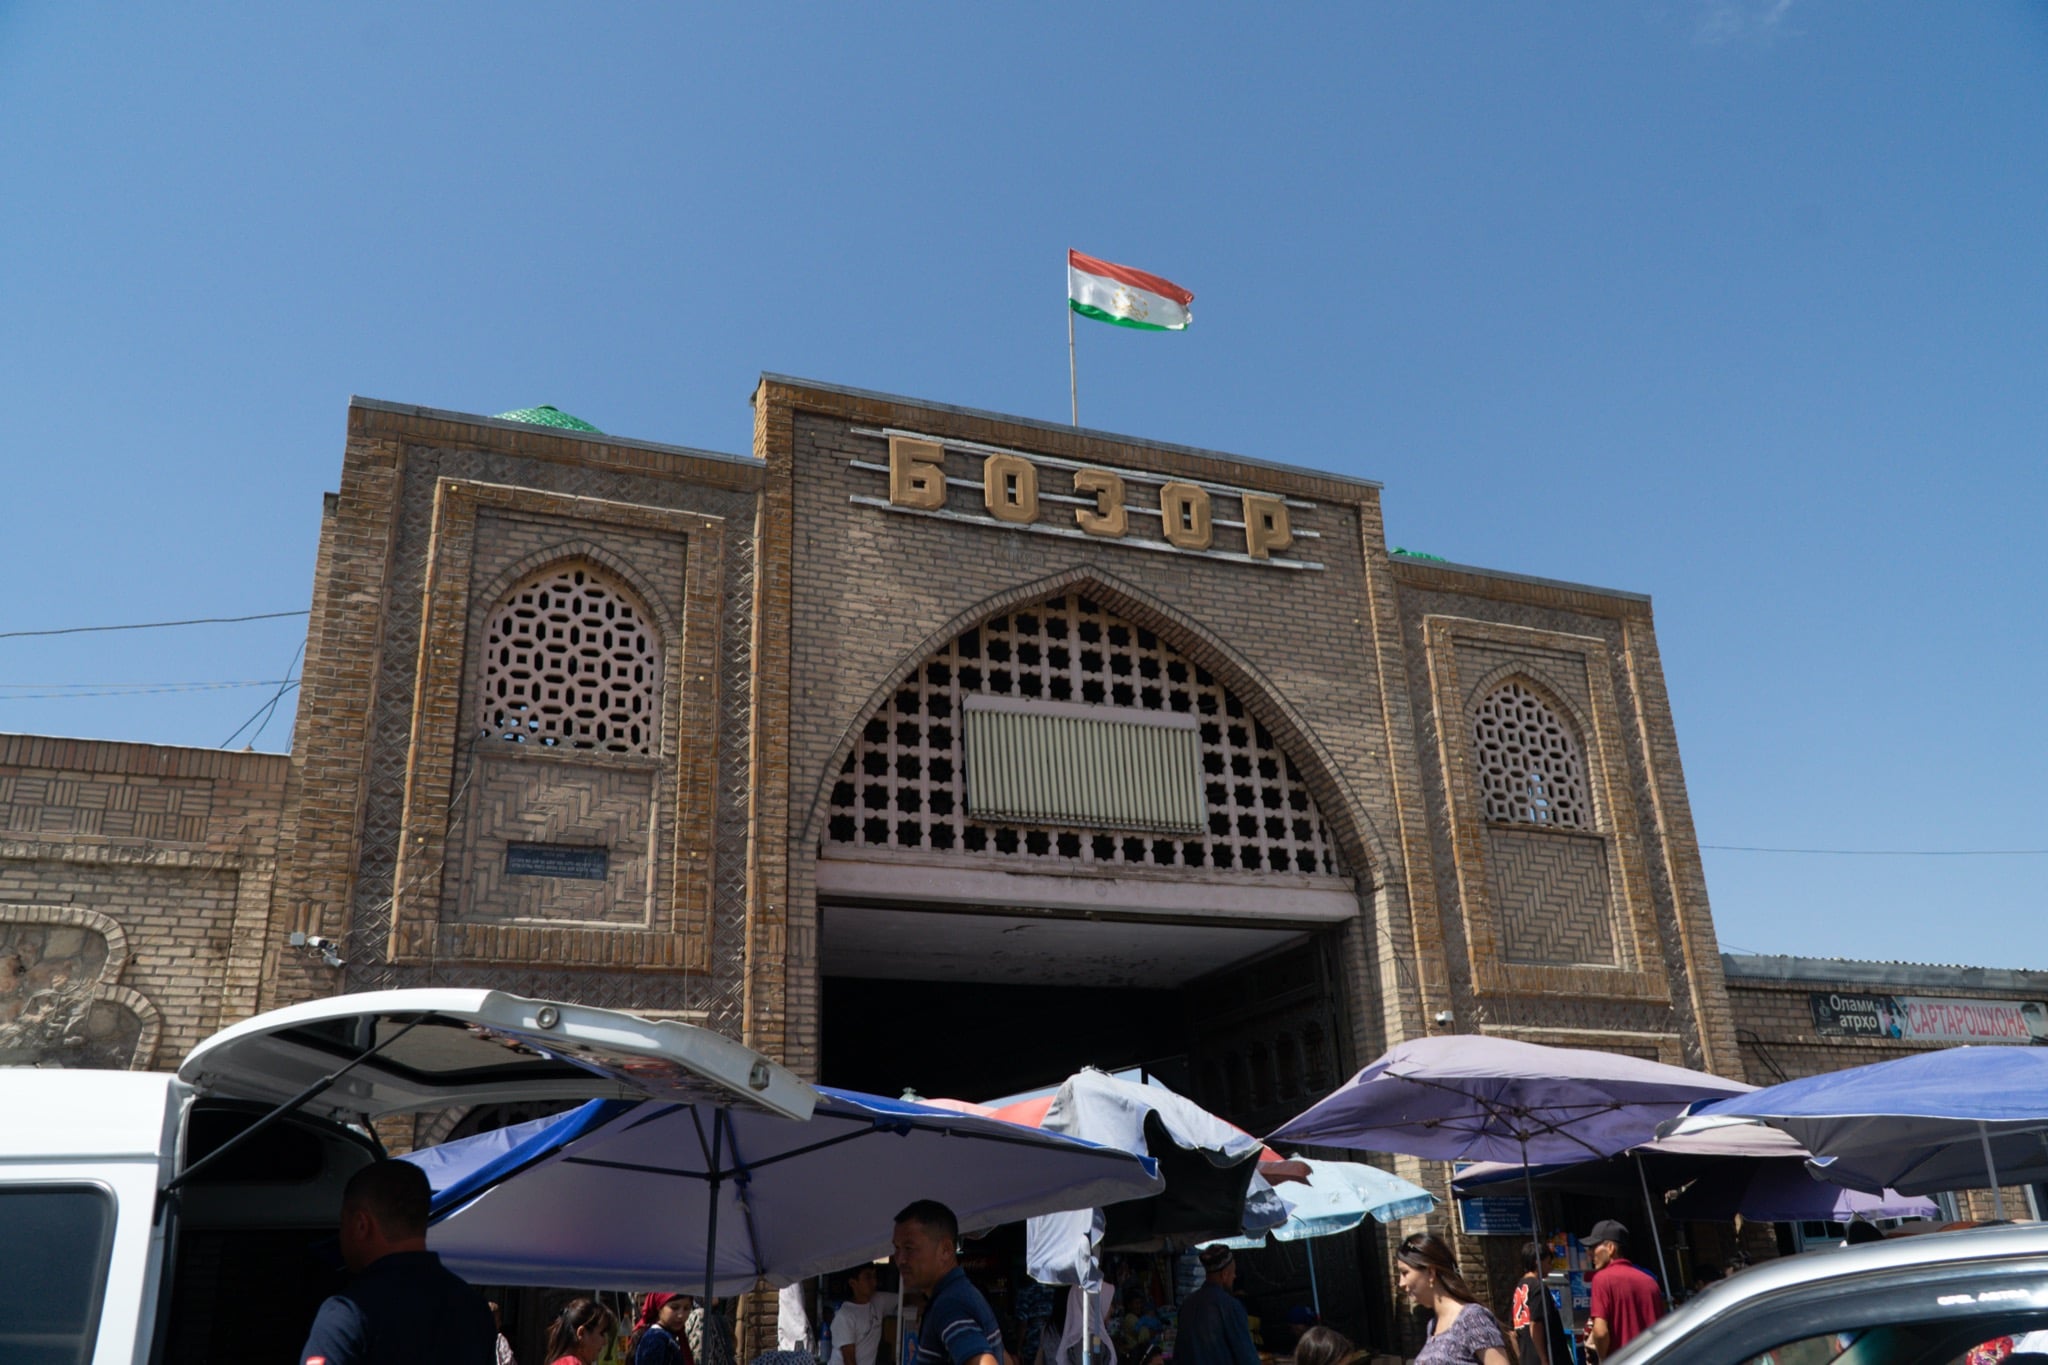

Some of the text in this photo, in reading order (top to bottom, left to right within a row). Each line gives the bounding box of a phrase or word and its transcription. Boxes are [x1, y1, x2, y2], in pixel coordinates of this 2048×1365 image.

[889, 436, 1293, 559] БОЗОР
[1830, 994, 1876, 1012] Олами
[1908, 1003, 2029, 1037] САРТАРОШХОНА
